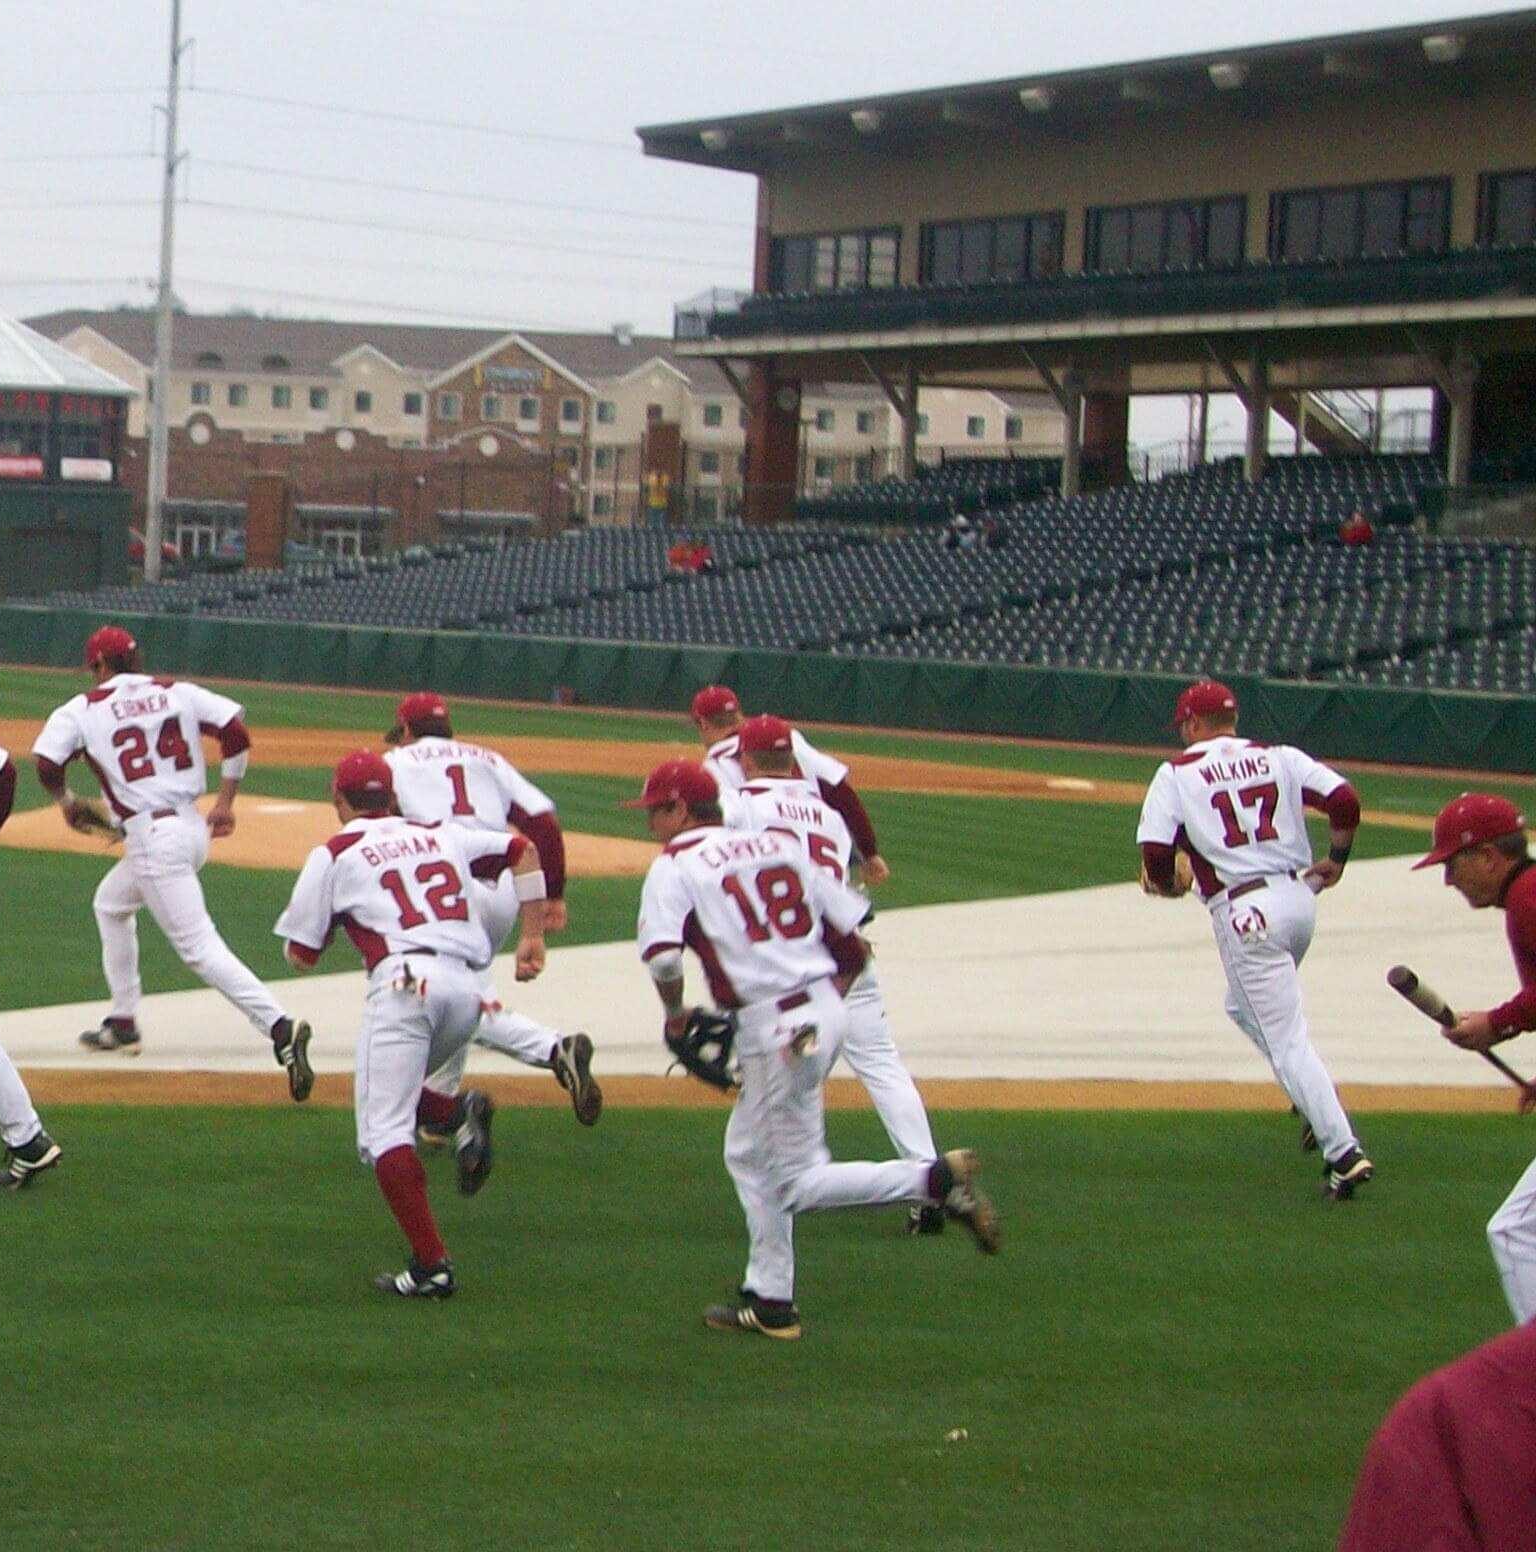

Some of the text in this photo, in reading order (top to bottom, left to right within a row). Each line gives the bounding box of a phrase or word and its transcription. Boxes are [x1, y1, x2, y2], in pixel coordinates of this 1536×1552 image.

[112, 713, 194, 783] 24
[1198, 755, 1271, 786] WILKINS
[445, 764, 476, 816] 1
[774, 801, 824, 826] KUHN
[1210, 781, 1280, 849] 17
[361, 836, 442, 867] BIGHAM
[379, 859, 470, 931] 12
[721, 864, 813, 942] 18
